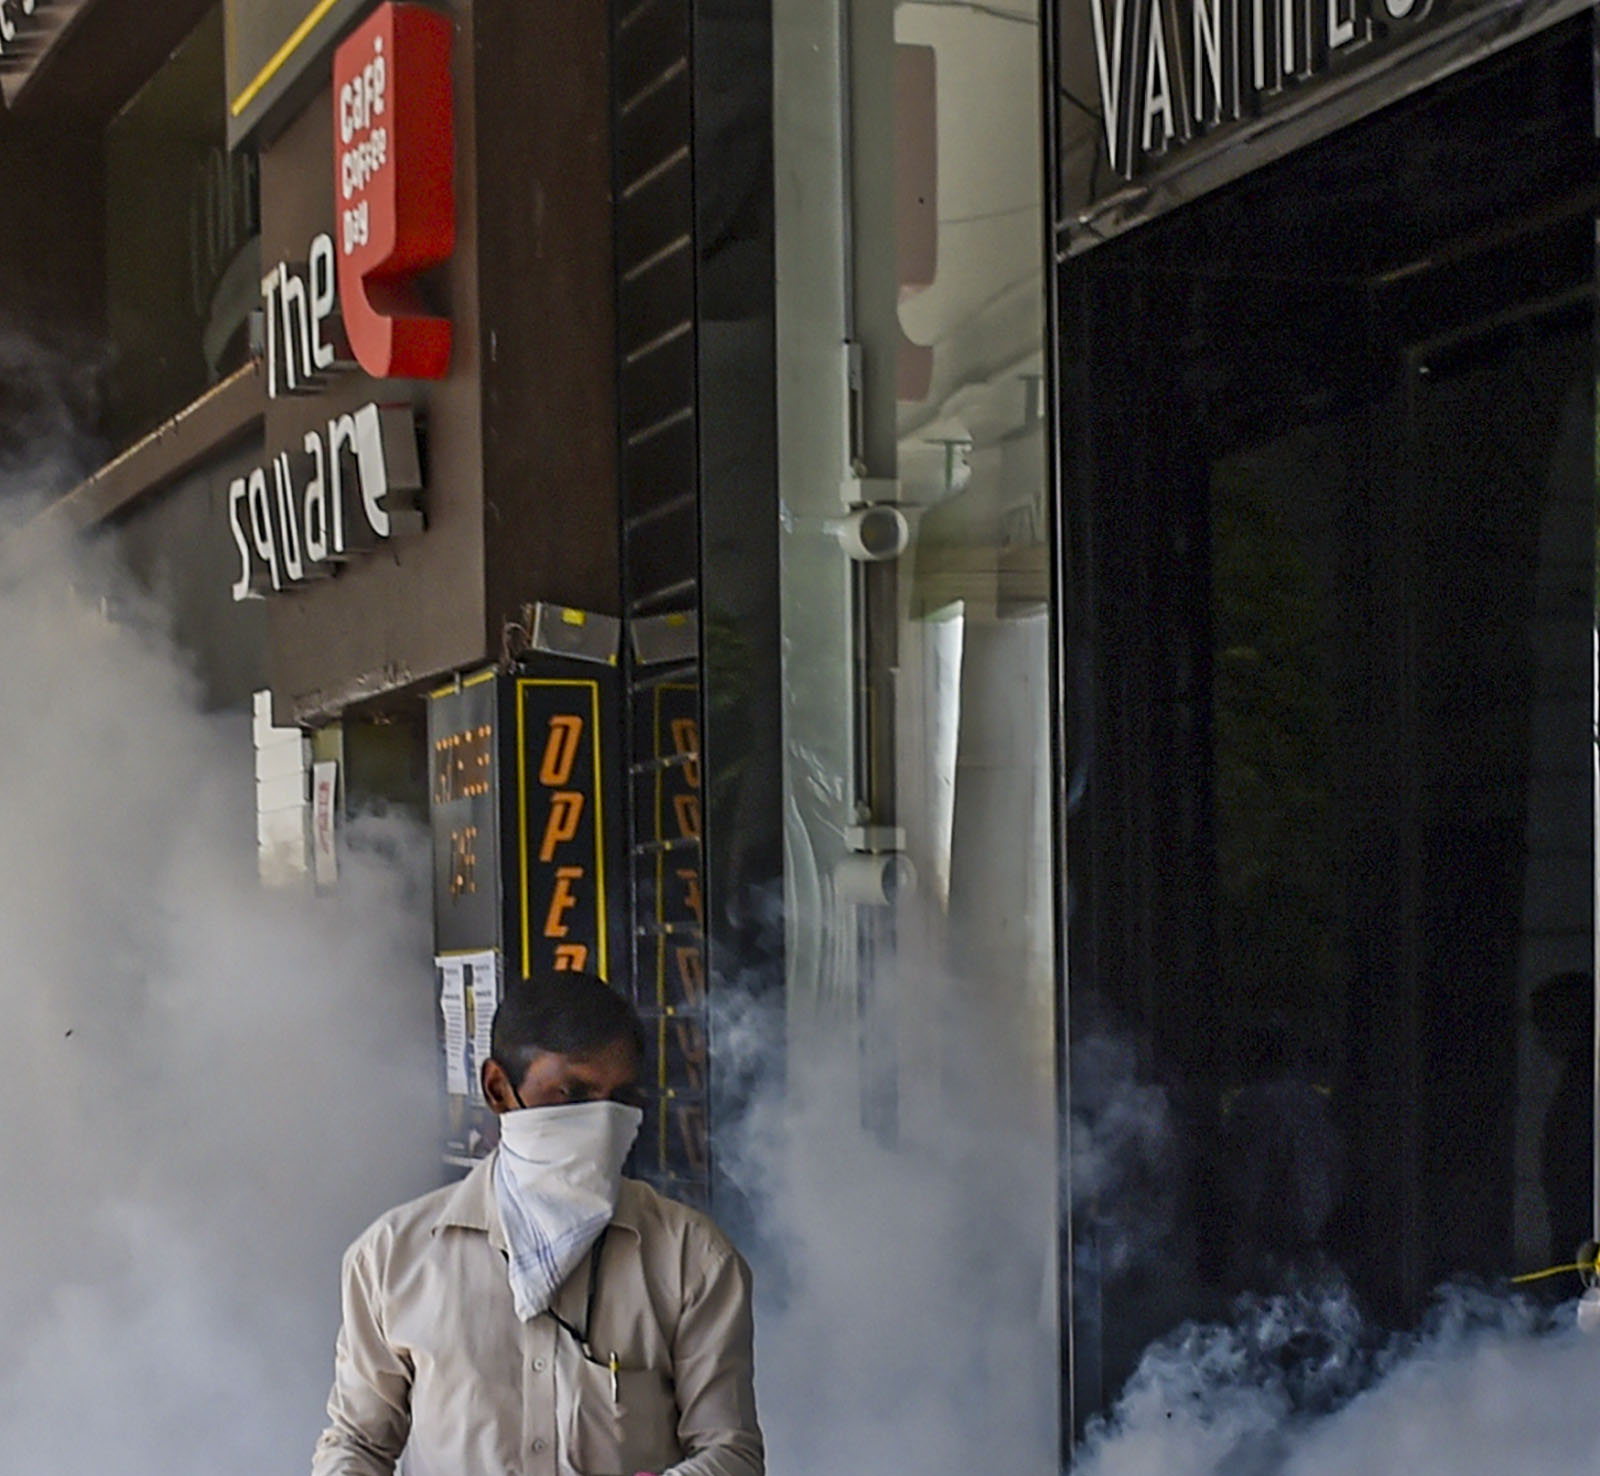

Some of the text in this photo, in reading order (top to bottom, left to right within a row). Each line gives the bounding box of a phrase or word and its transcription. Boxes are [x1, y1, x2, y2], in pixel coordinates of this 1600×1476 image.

[340, 34, 386, 144] Café
[342, 126, 387, 200] Coffee
[343, 199, 369, 255] Day
[261, 232, 335, 399] The
